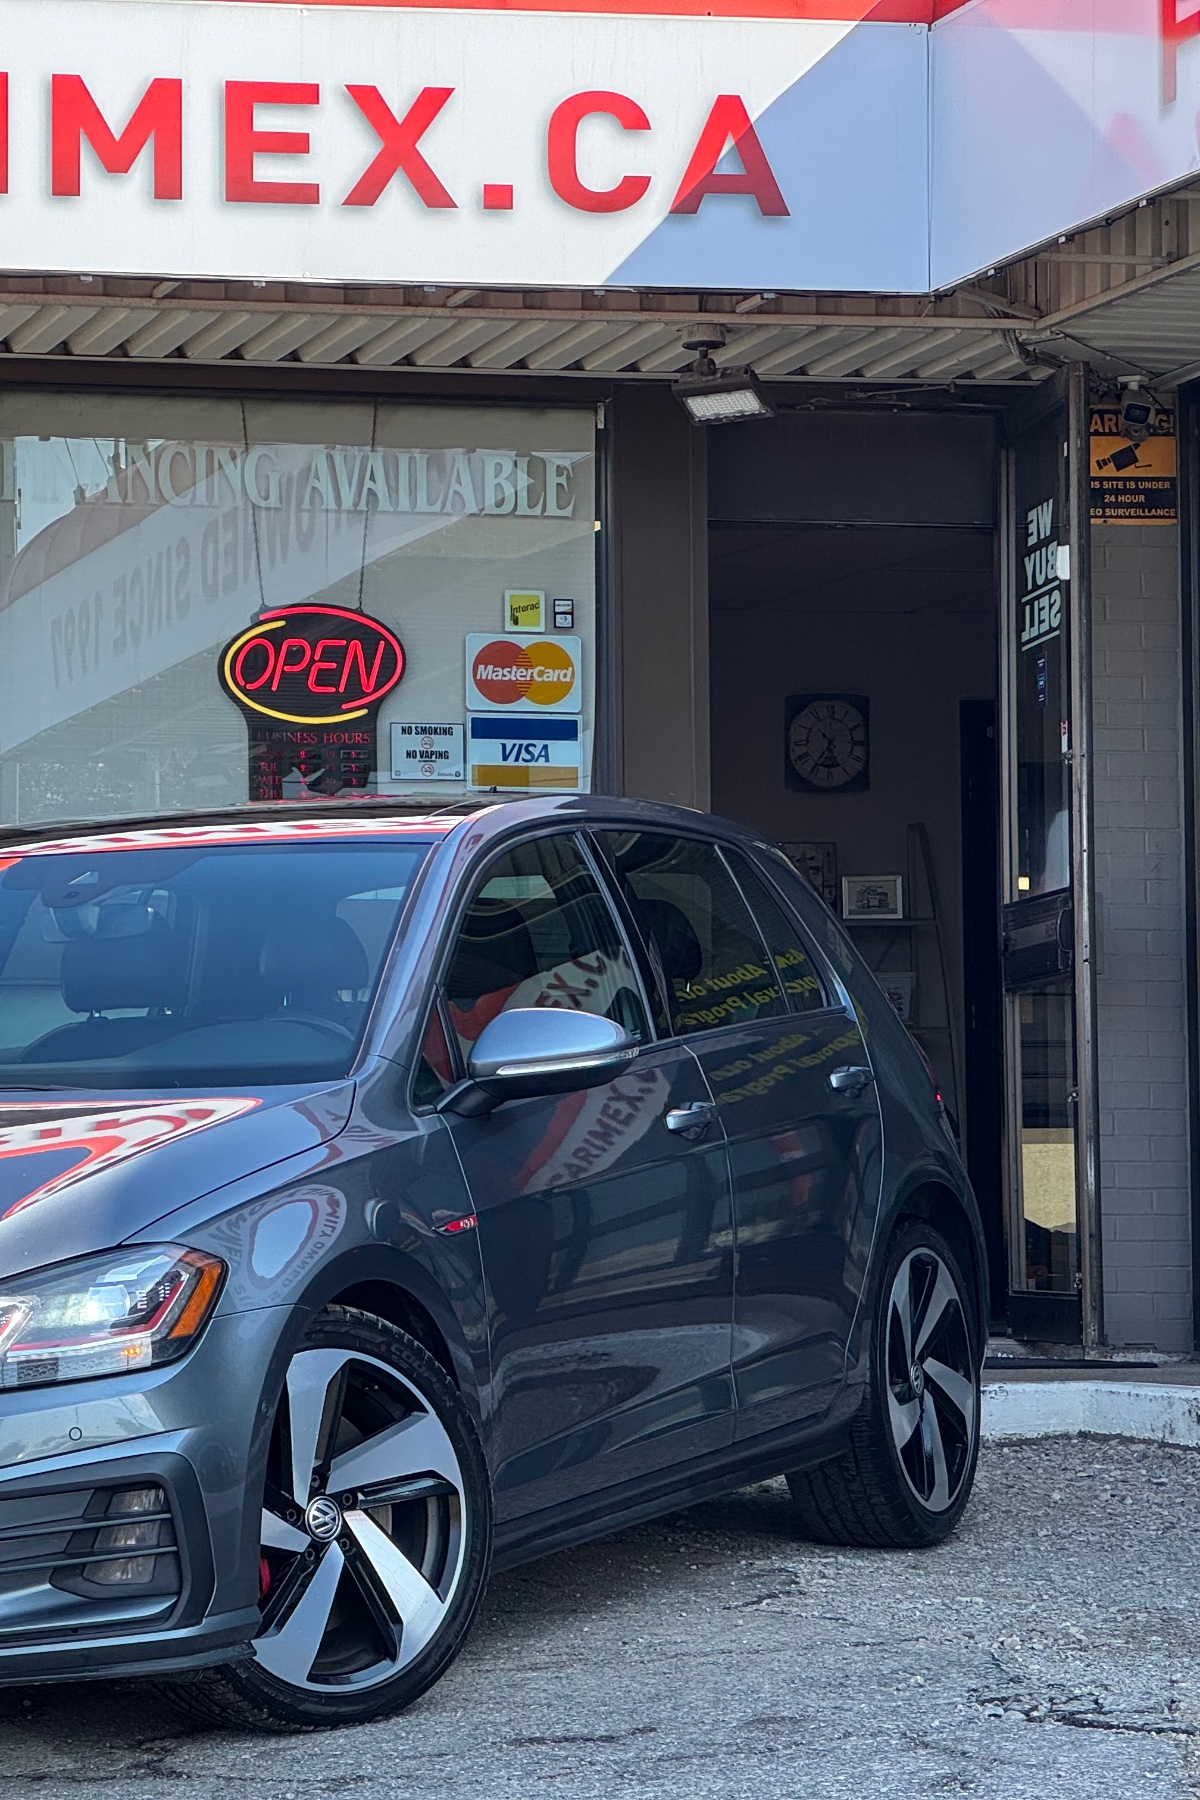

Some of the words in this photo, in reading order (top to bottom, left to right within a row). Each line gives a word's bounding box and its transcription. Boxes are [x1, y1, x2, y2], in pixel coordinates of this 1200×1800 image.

[301, 450, 575, 517] AVAILABLE
[1102, 481, 1125, 489] SITE
[1126, 481, 1137, 489] IS
[1138, 481, 1171, 489] UNDER
[1104, 494, 1116, 503] 24
[1117, 494, 1146, 503] HOUR
[1104, 508, 1176, 516] SURVEILLANCE
[511, 602, 541, 614] Interac
[235, 638, 386, 693] OPEN
[476, 664, 573, 682] MasterCard
[401, 725, 413, 735] NO
[414, 725, 454, 736] SMOKING
[323, 732, 371, 744] HOURS
[406, 749, 418, 759] NO
[419, 749, 450, 760] VAPING
[500, 742, 550, 763] VISA
